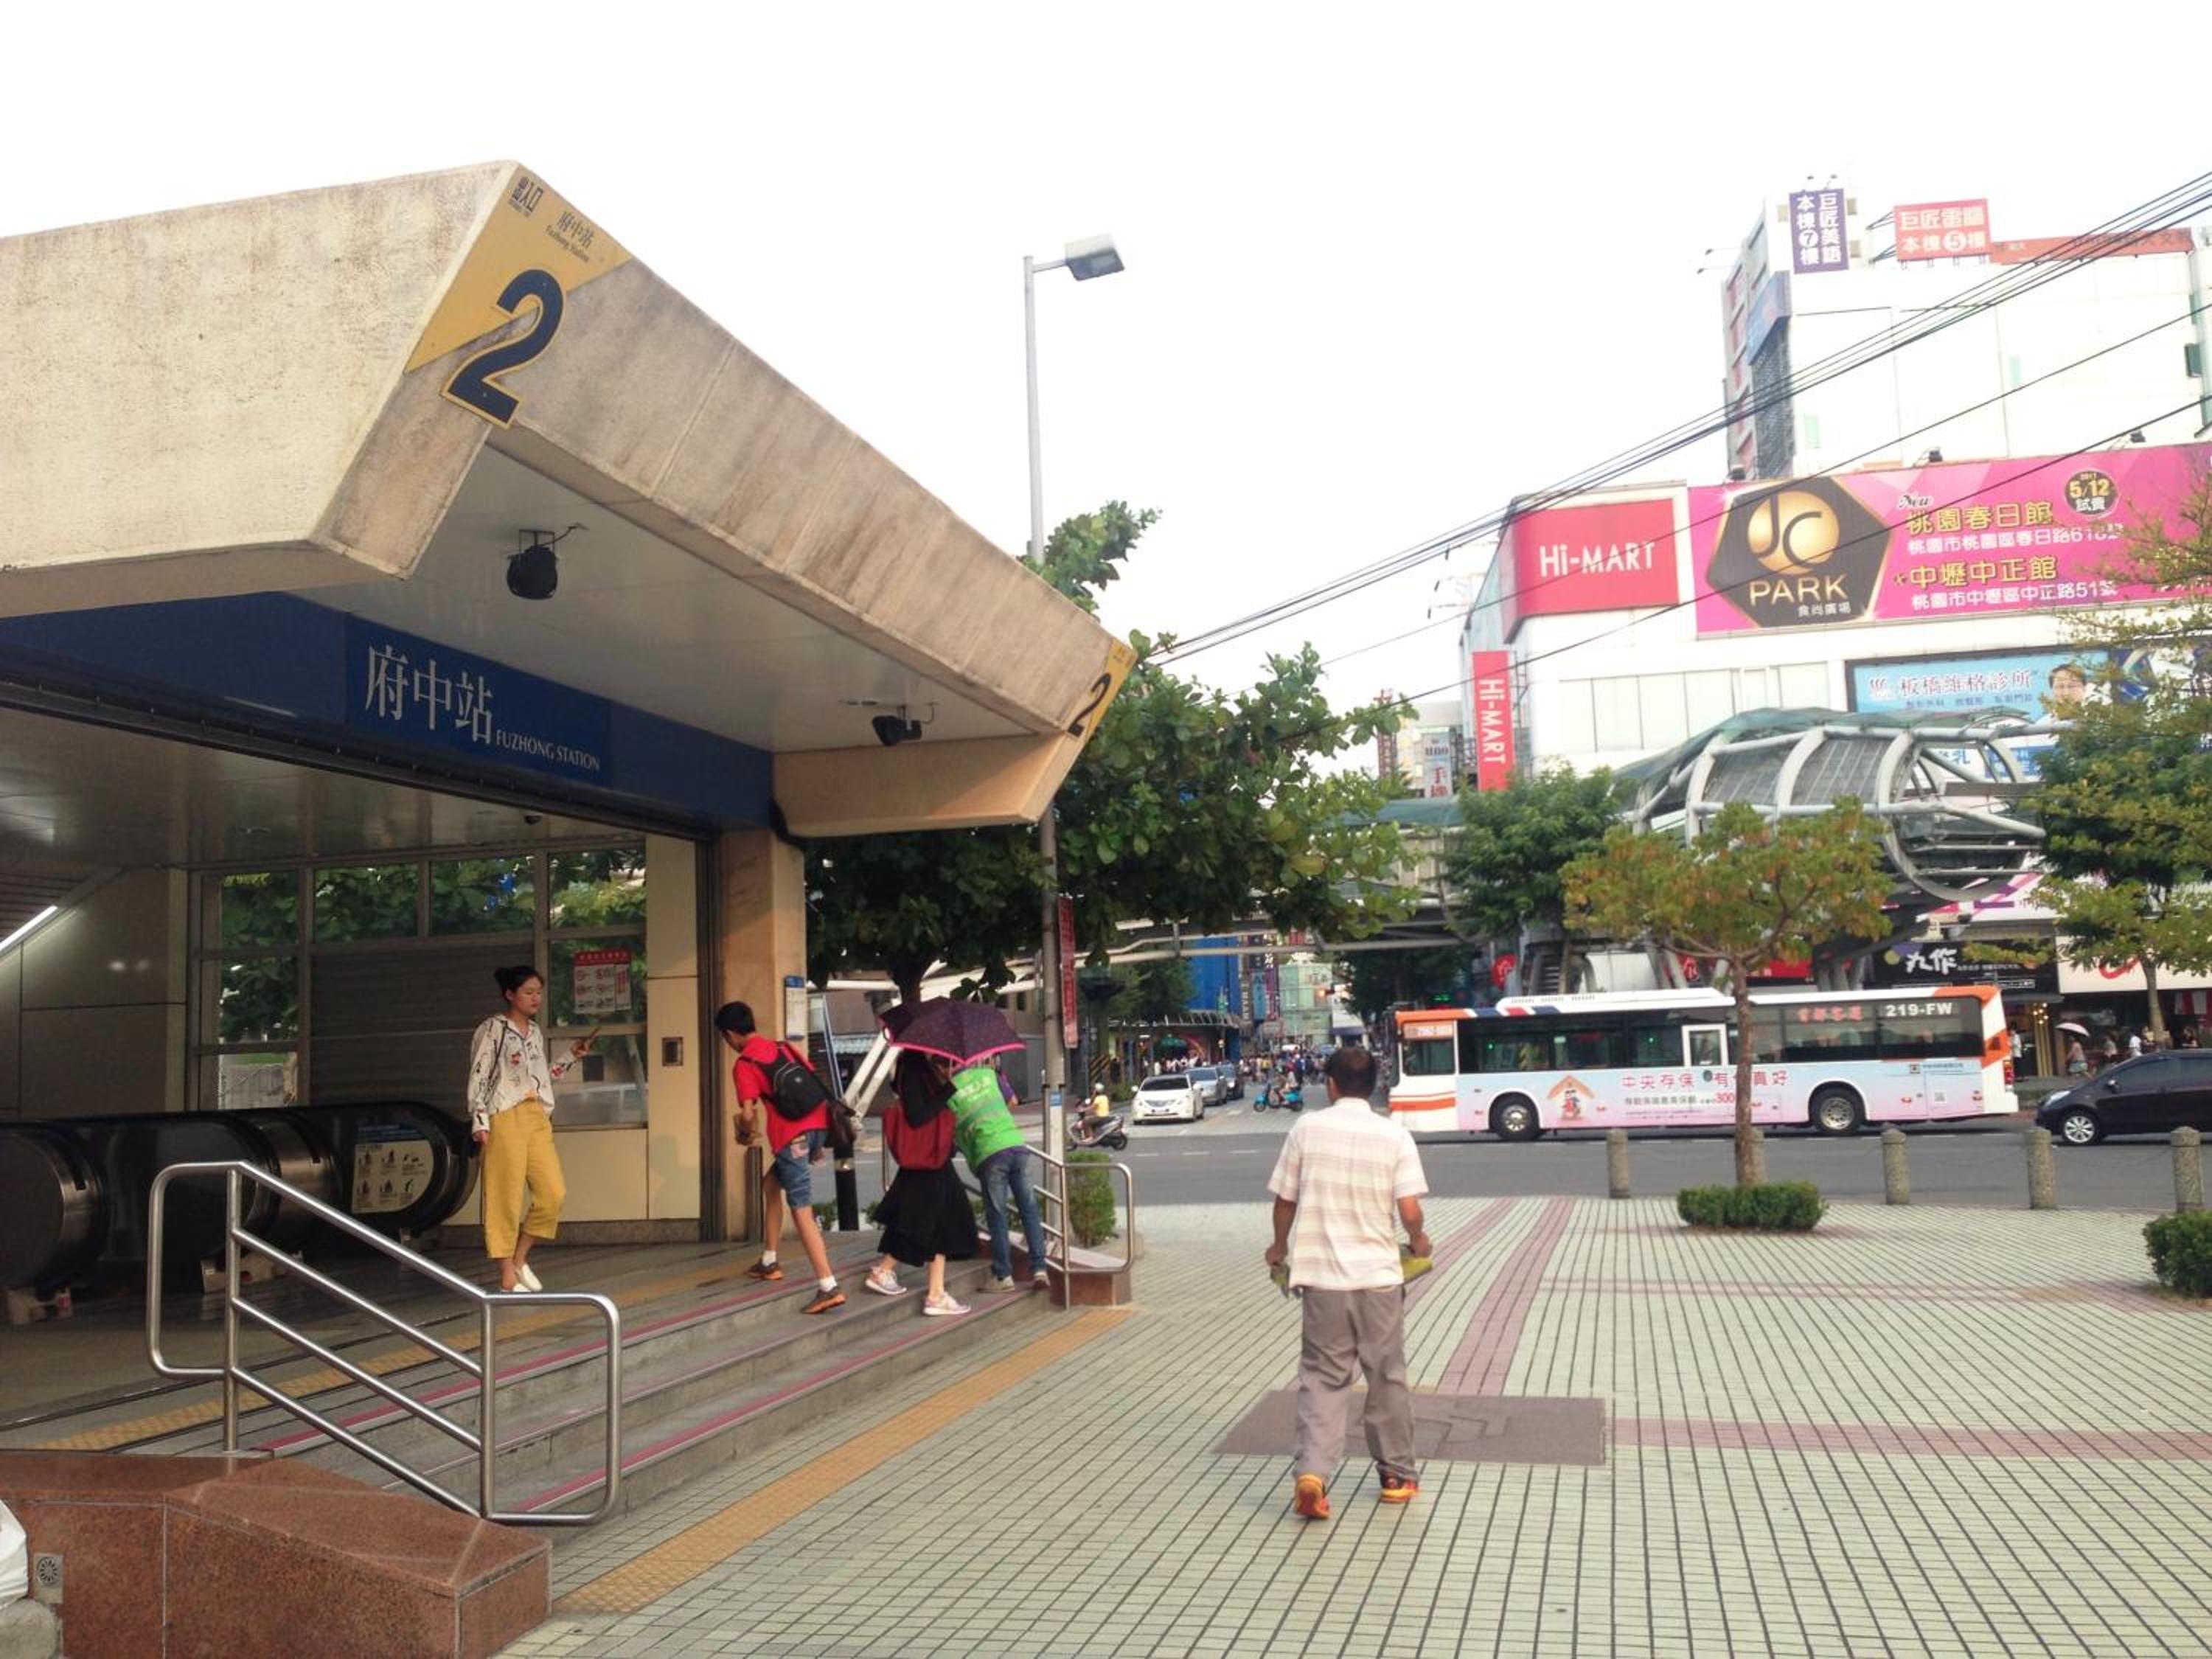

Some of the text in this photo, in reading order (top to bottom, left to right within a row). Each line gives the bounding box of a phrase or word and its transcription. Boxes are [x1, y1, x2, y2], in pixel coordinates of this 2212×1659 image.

[447, 268, 564, 424] 2
[2069, 478, 2110, 498] 5/12
[1906, 500, 2053, 535] 桃園春日館
[1539, 541, 1655, 578] Hi-MART
[1910, 554, 2058, 591] 中壢中正館
[1749, 574, 1848, 606] PARK
[365, 644, 493, 744] 府中站
[1478, 678, 1507, 765] Hi-MART
[496, 728, 601, 771] FUZHONG STATION
[1885, 1002, 1954, 1018] 219-FW
[1714, 1070, 1788, 1087] 有真好
